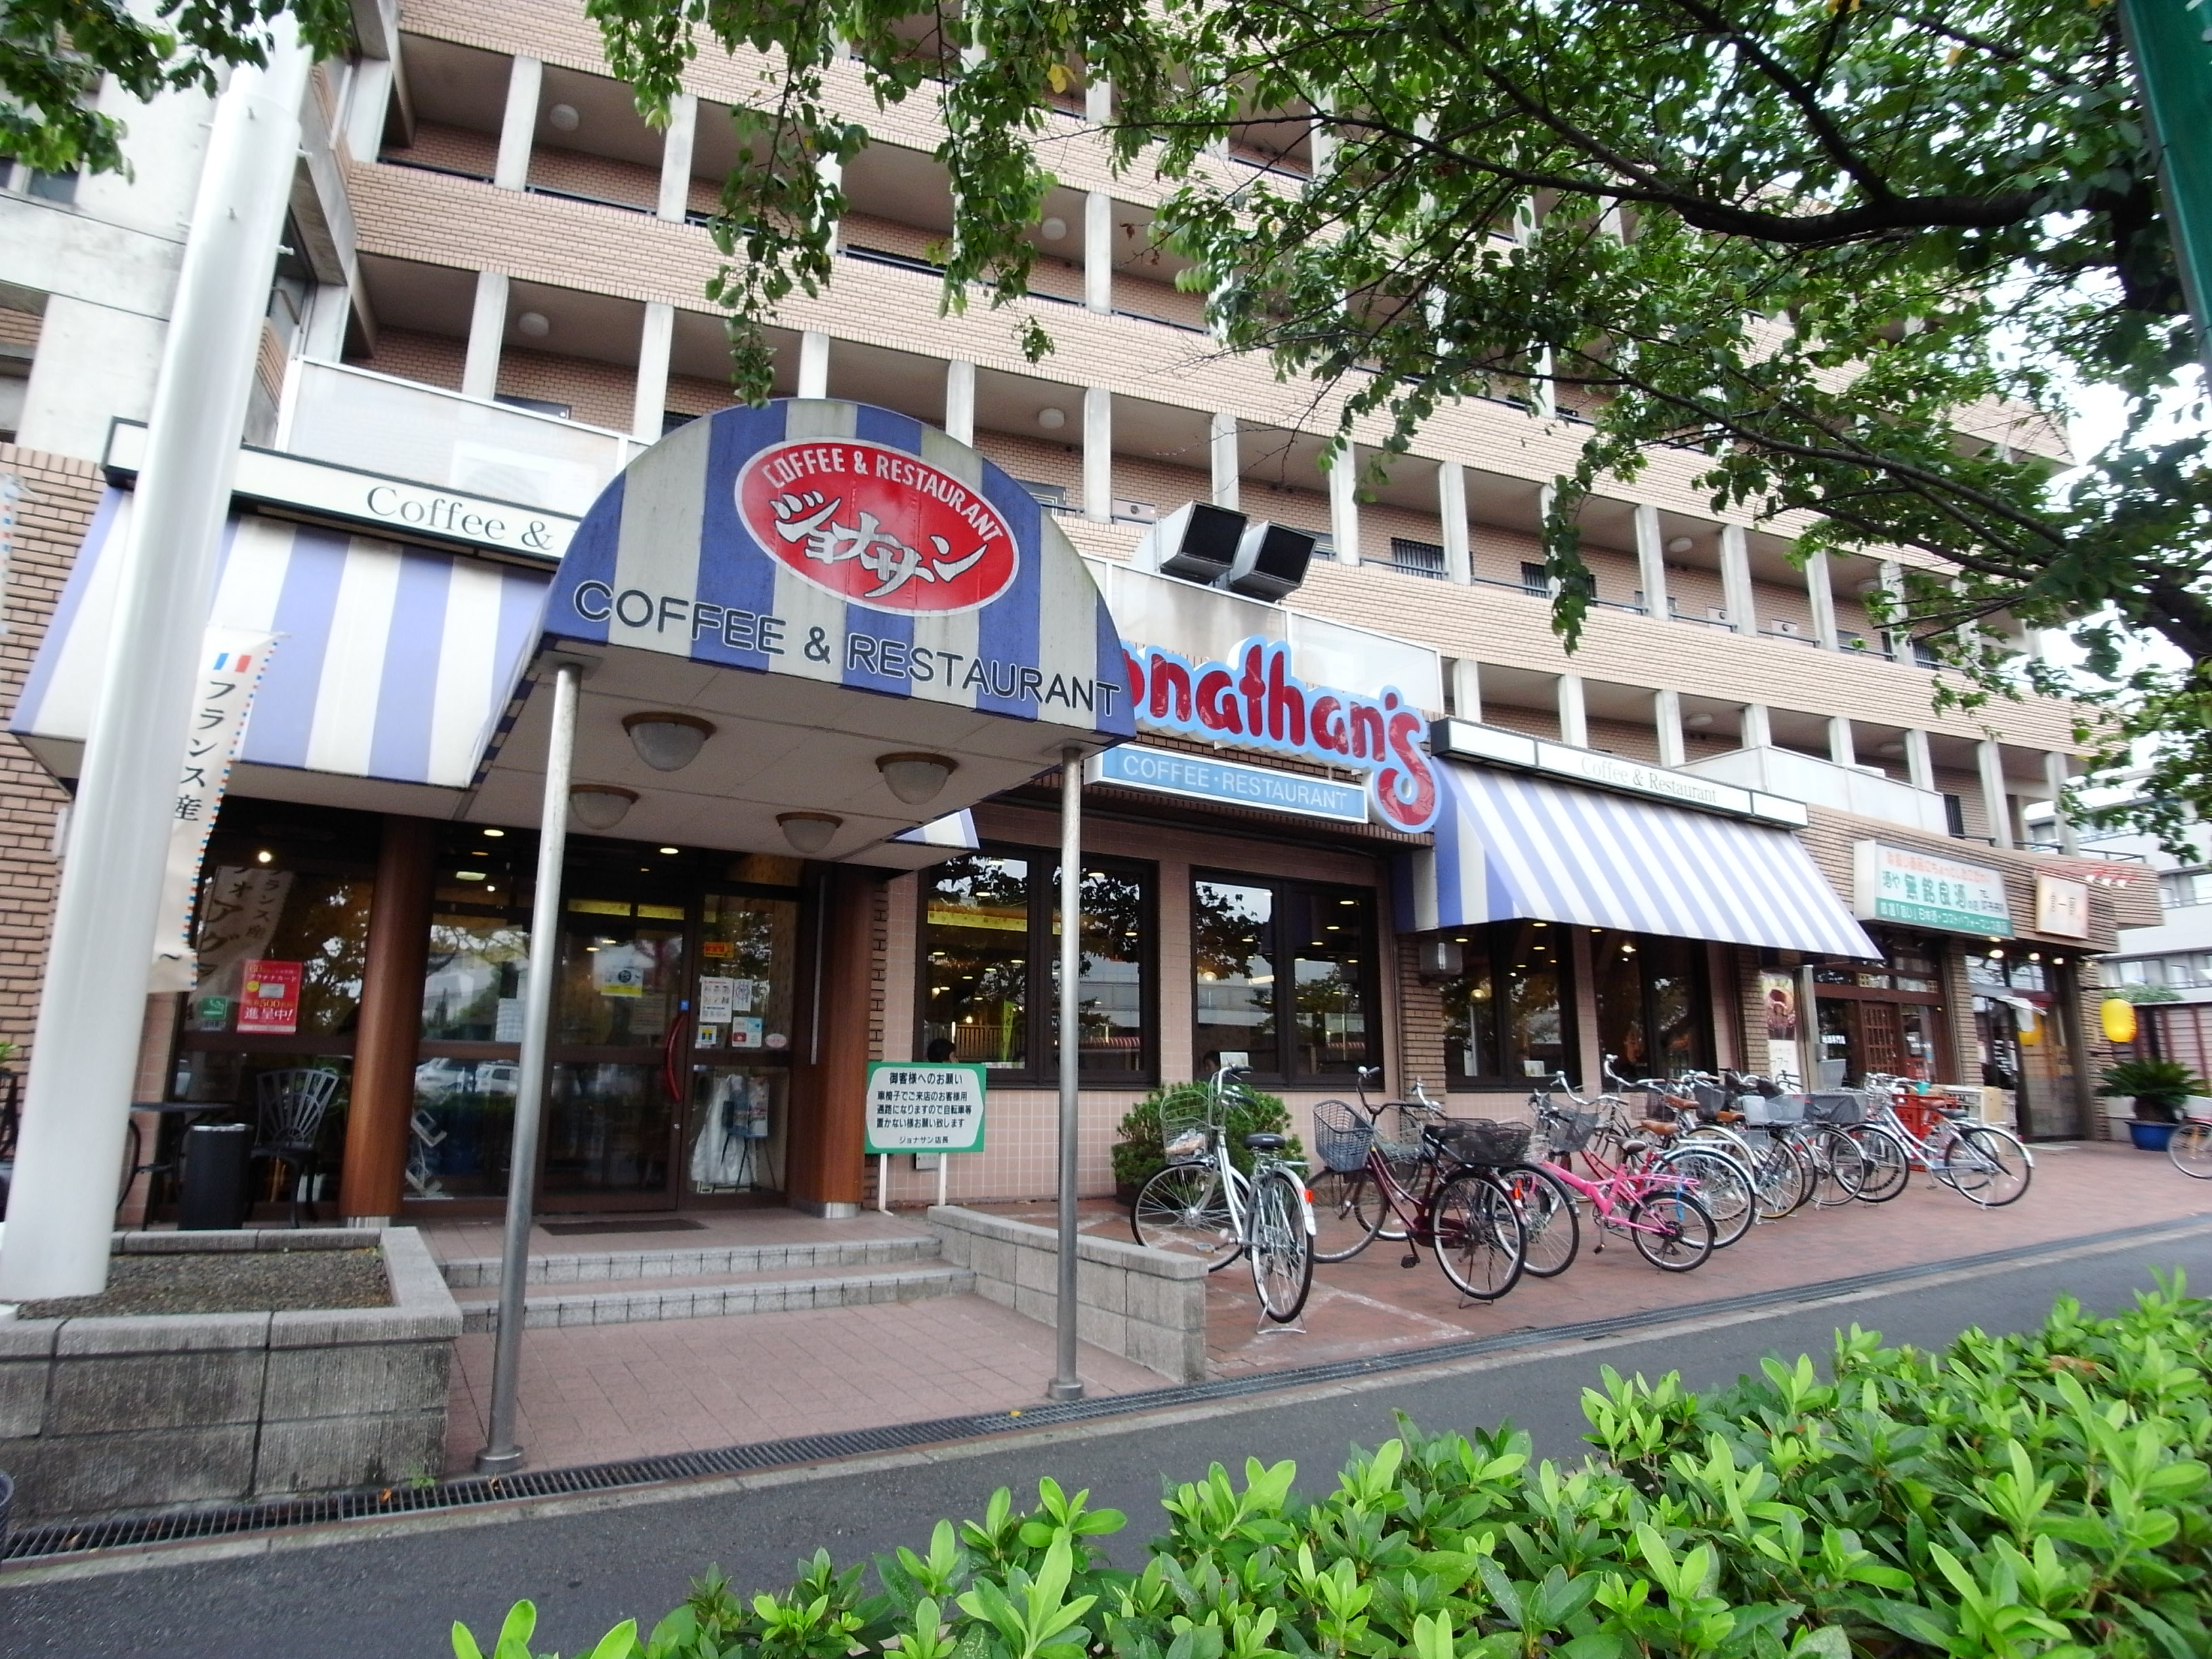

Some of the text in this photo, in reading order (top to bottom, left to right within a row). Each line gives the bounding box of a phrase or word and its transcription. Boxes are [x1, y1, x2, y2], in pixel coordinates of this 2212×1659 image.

[367, 486, 554, 550] Coffee &
[763, 448, 1004, 541] COFFEE & RESTAURANT
[769, 490, 989, 598] ジョナサン
[573, 579, 1122, 717] COFFEE & RESTAURANT
[174, 680, 237, 822] フランス産
[1122, 644, 1435, 827] nathan's
[1581, 756, 1717, 803] Coffee & Restaurant
[877, 1090, 968, 1101] 車椅子でご来店のお客様用
[889, 1072, 963, 1085] 御客様へのお願い
[876, 1104, 972, 1115] 通路になりますので自転車等
[876, 1118, 965, 1128] 置かない様お願い致します
[899, 1135, 949, 1144] ジョナサン店長
